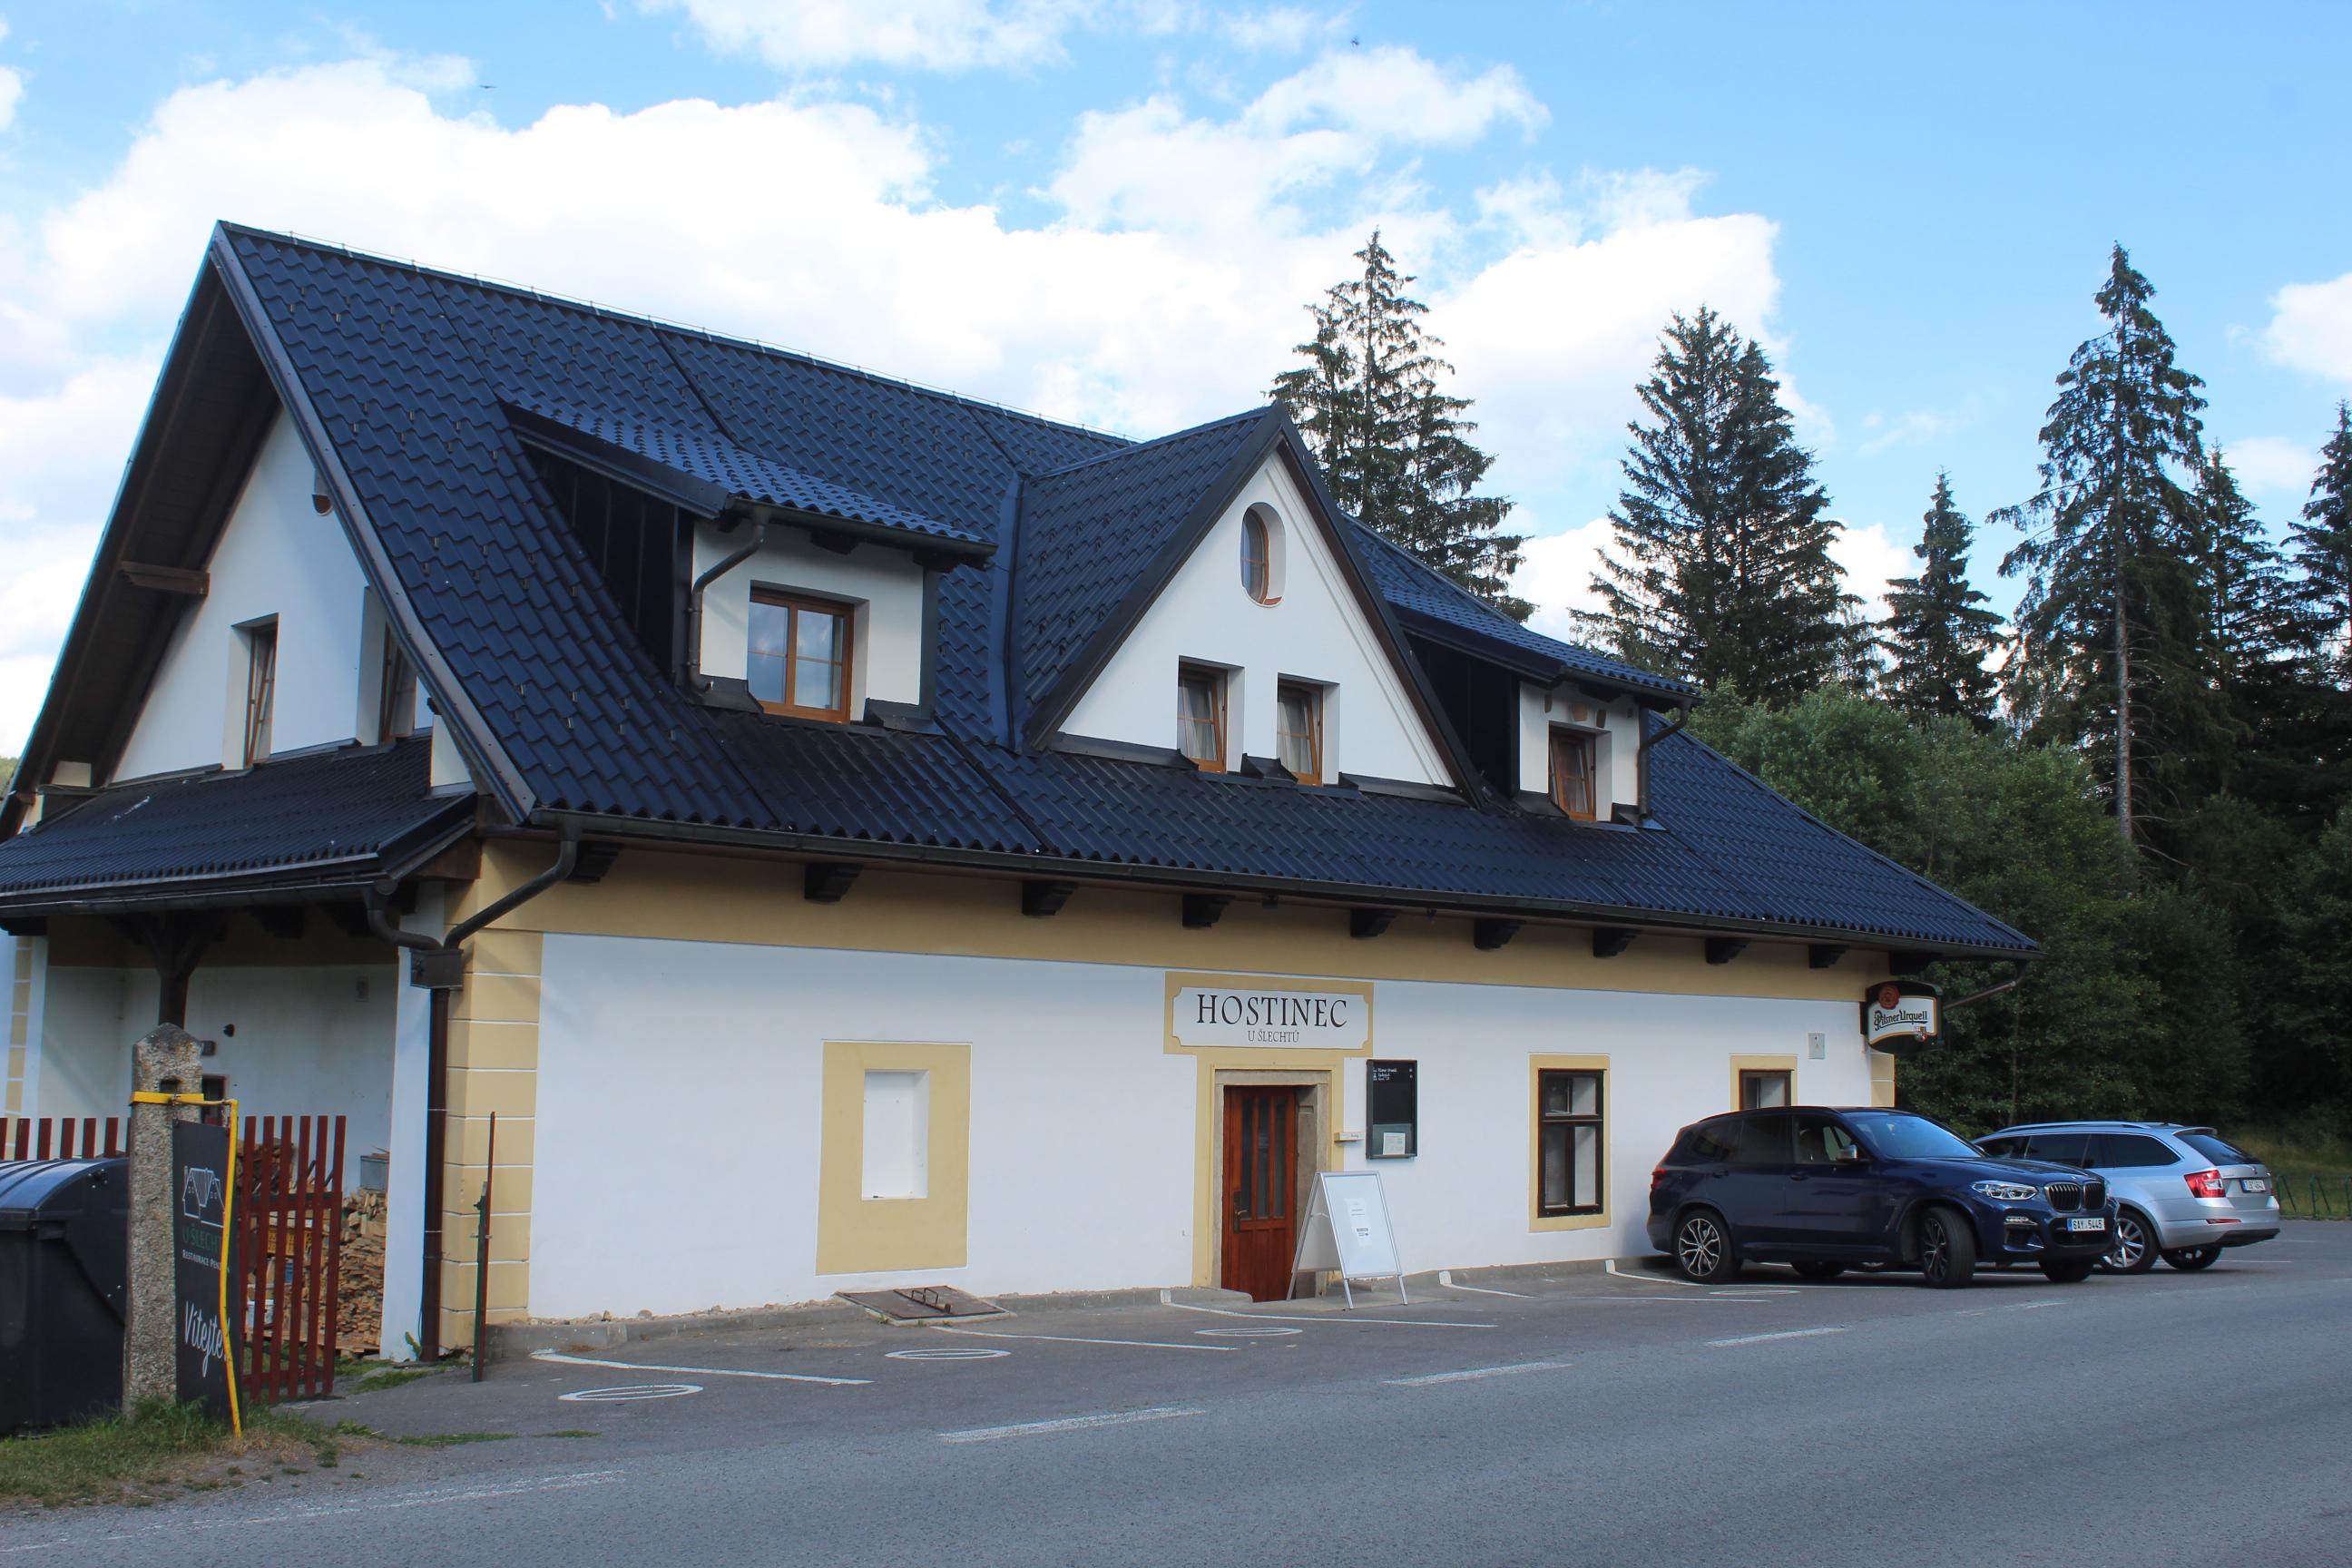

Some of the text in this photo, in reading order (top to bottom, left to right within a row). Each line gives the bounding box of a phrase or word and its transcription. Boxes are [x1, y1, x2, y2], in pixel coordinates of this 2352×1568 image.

[1196, 994, 1348, 1028] HOSTINEC
[1874, 1009, 1927, 1031] Pilsner Urquell
[1247, 1030, 1255, 1042] U
[2088, 1220, 2102, 1230] 5445
